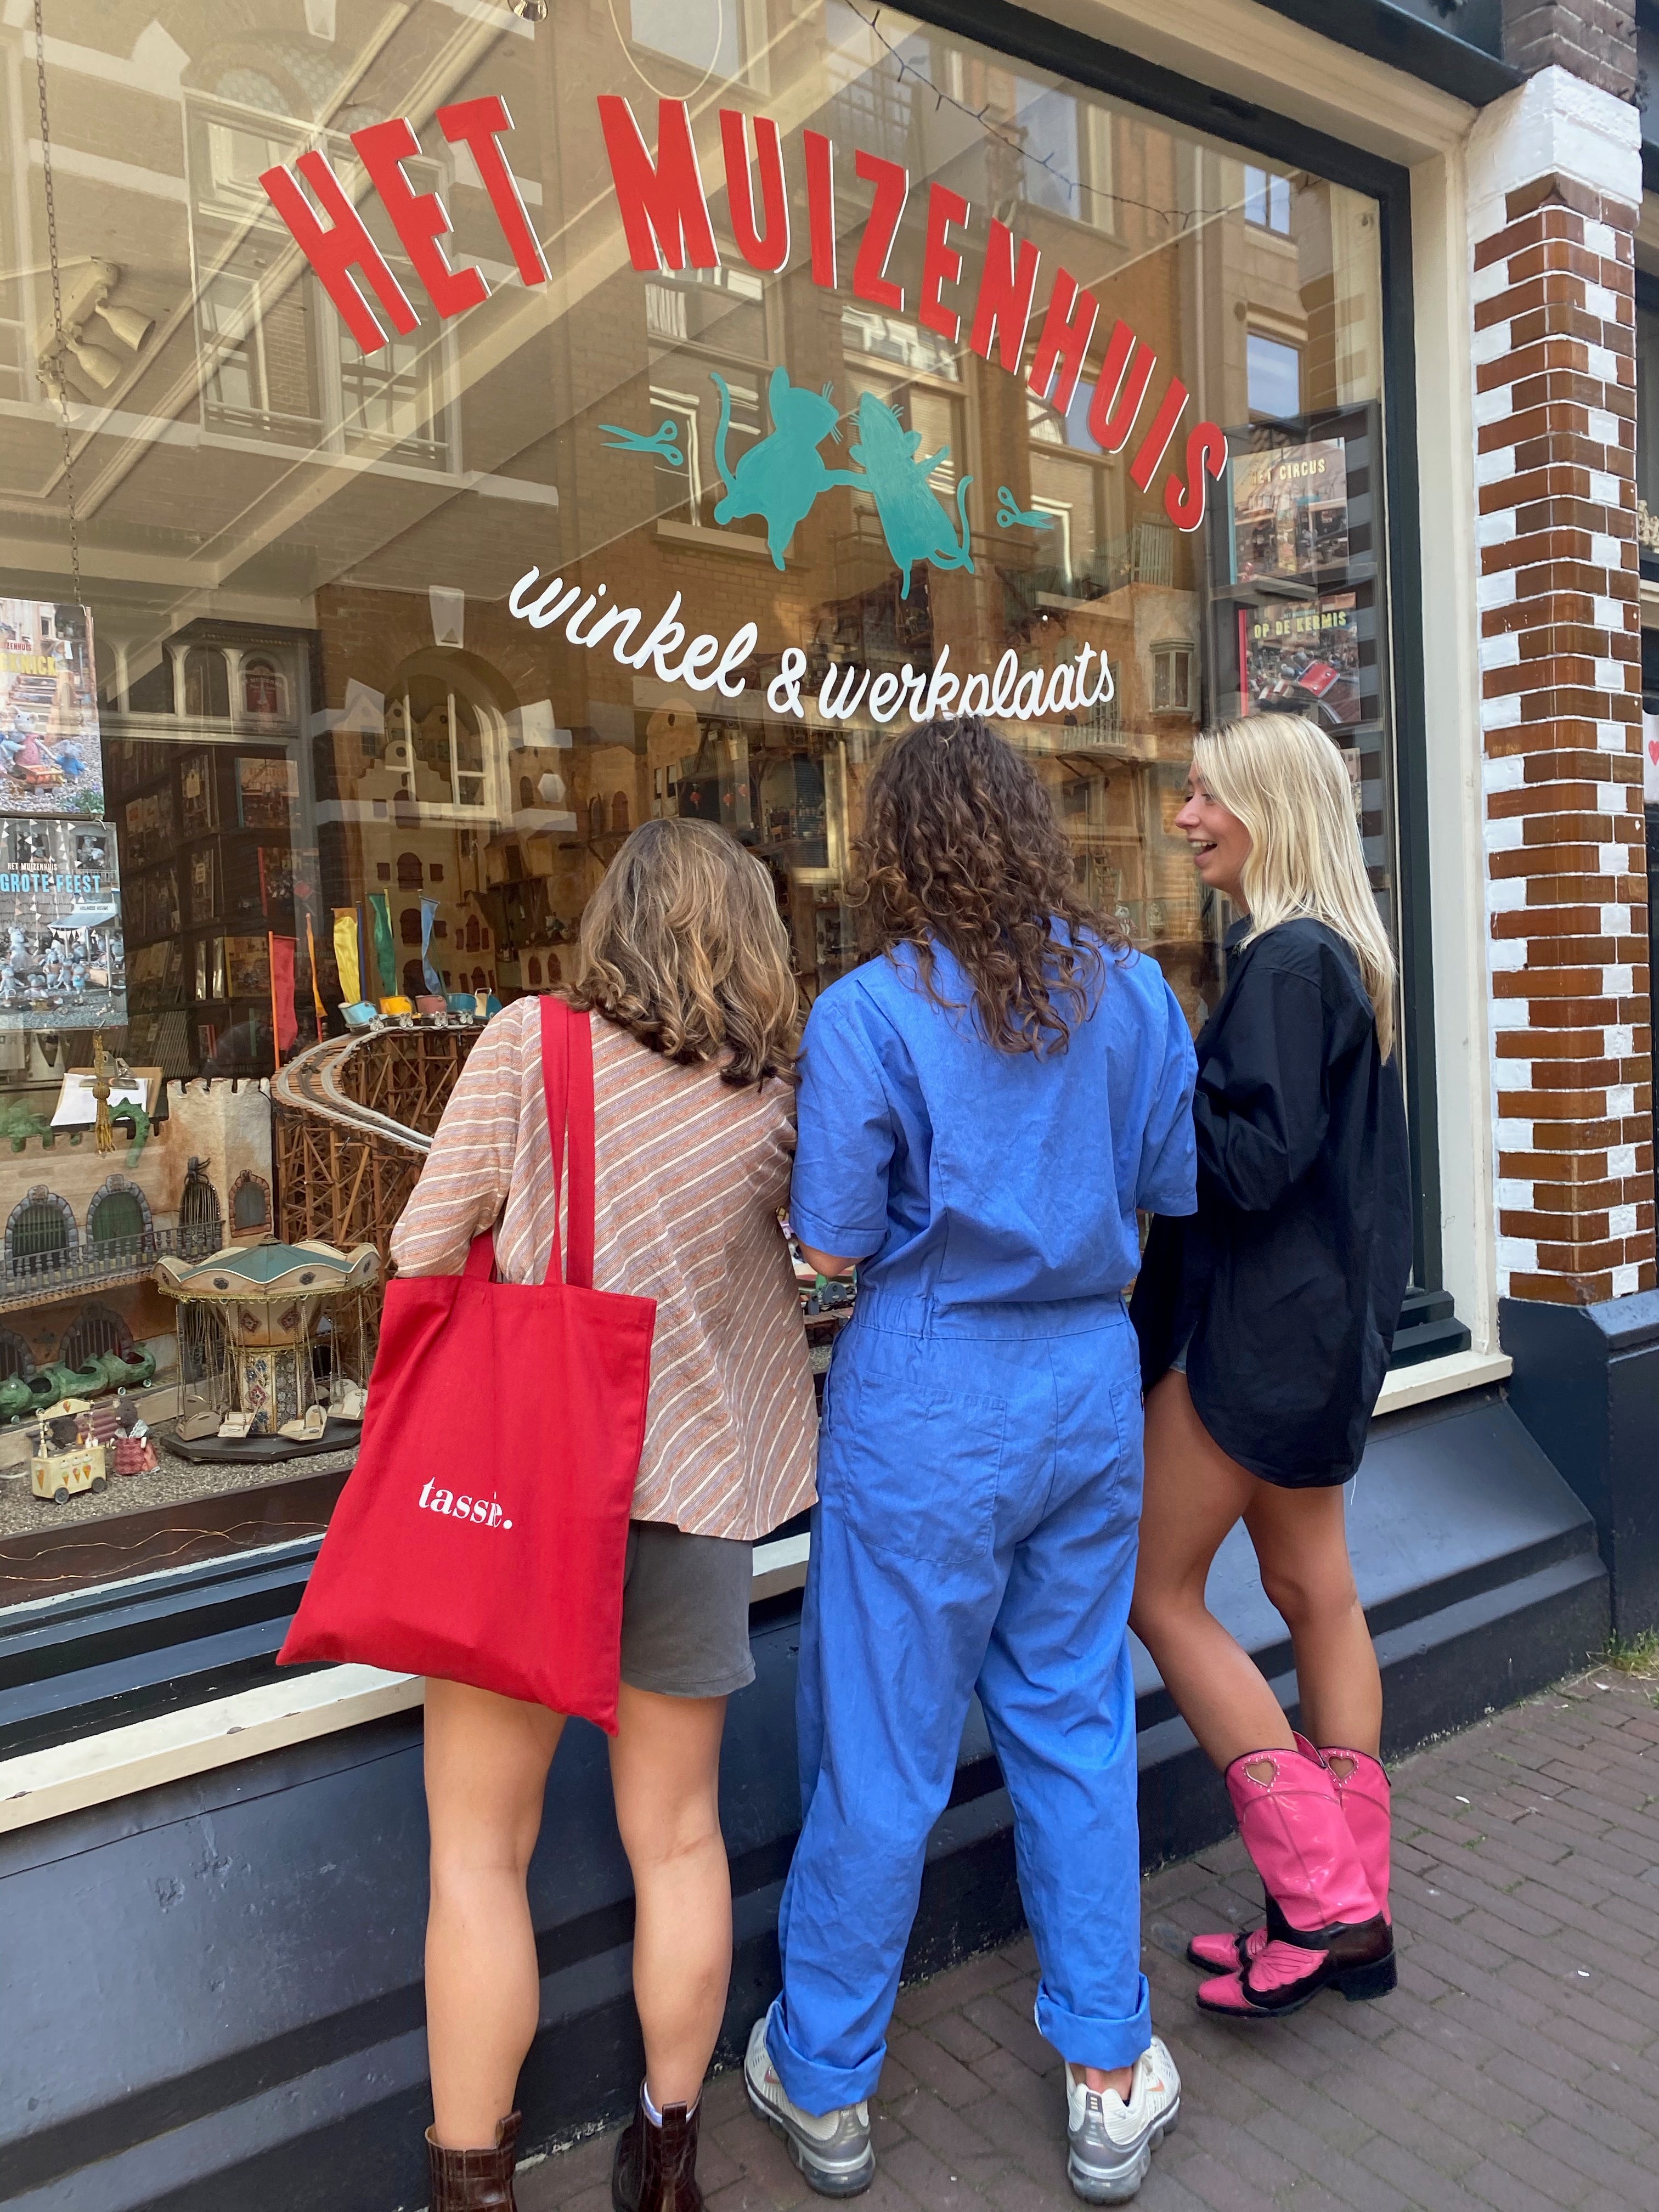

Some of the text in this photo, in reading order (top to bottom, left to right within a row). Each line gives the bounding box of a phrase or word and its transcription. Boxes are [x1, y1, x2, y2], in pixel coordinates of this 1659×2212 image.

[259, 94, 1227, 531] HET MUIZENHUIS
[1280, 458, 1325, 480] CIRCUS
[1254, 623, 1269, 639] OP
[1276, 620, 1290, 635] DE
[1297, 611, 1347, 632] KERMIS
[509, 565, 758, 697] winkel
[768, 647, 807, 718] &
[21, 862, 58, 871] MUIZENHUIS
[0, 873, 100, 893] GROTE FEEST
